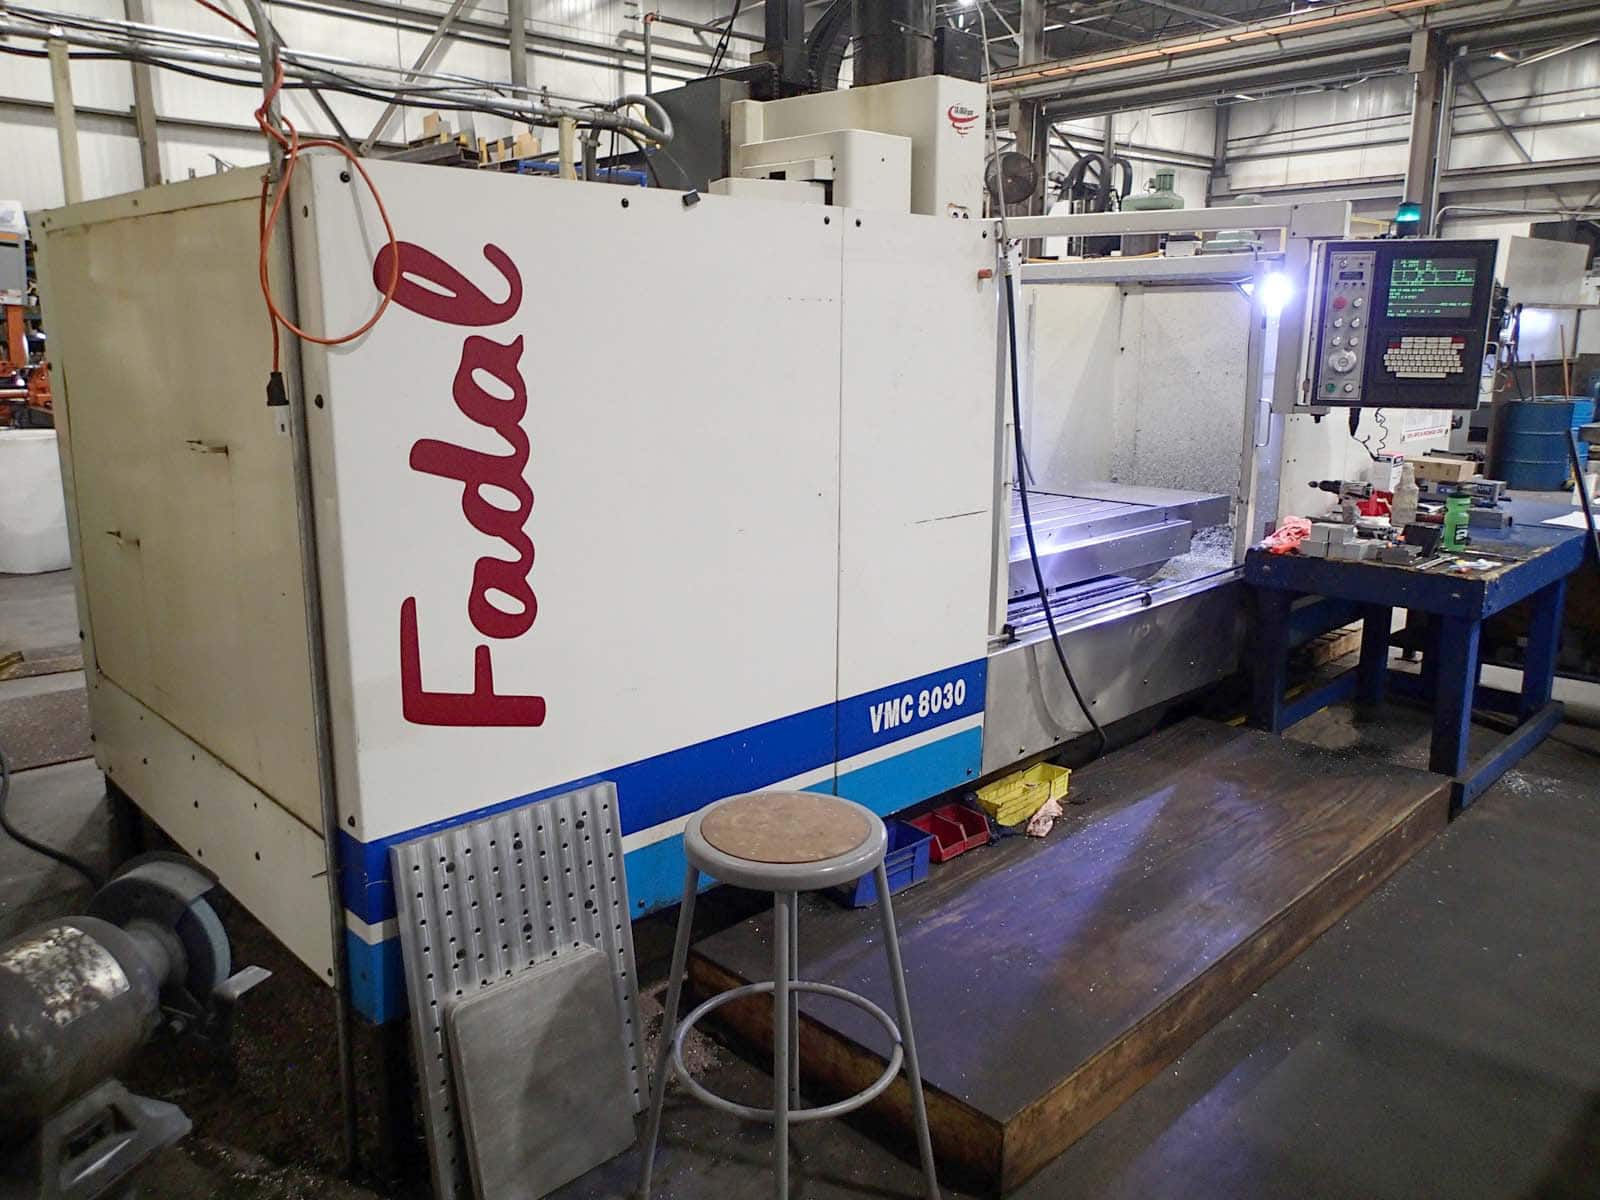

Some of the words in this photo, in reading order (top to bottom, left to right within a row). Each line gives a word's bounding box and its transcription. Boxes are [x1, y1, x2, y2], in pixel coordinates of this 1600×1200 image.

[373, 241, 546, 727] Fadal
[869, 694, 914, 734] VMC
[918, 679, 966, 718] 8030
